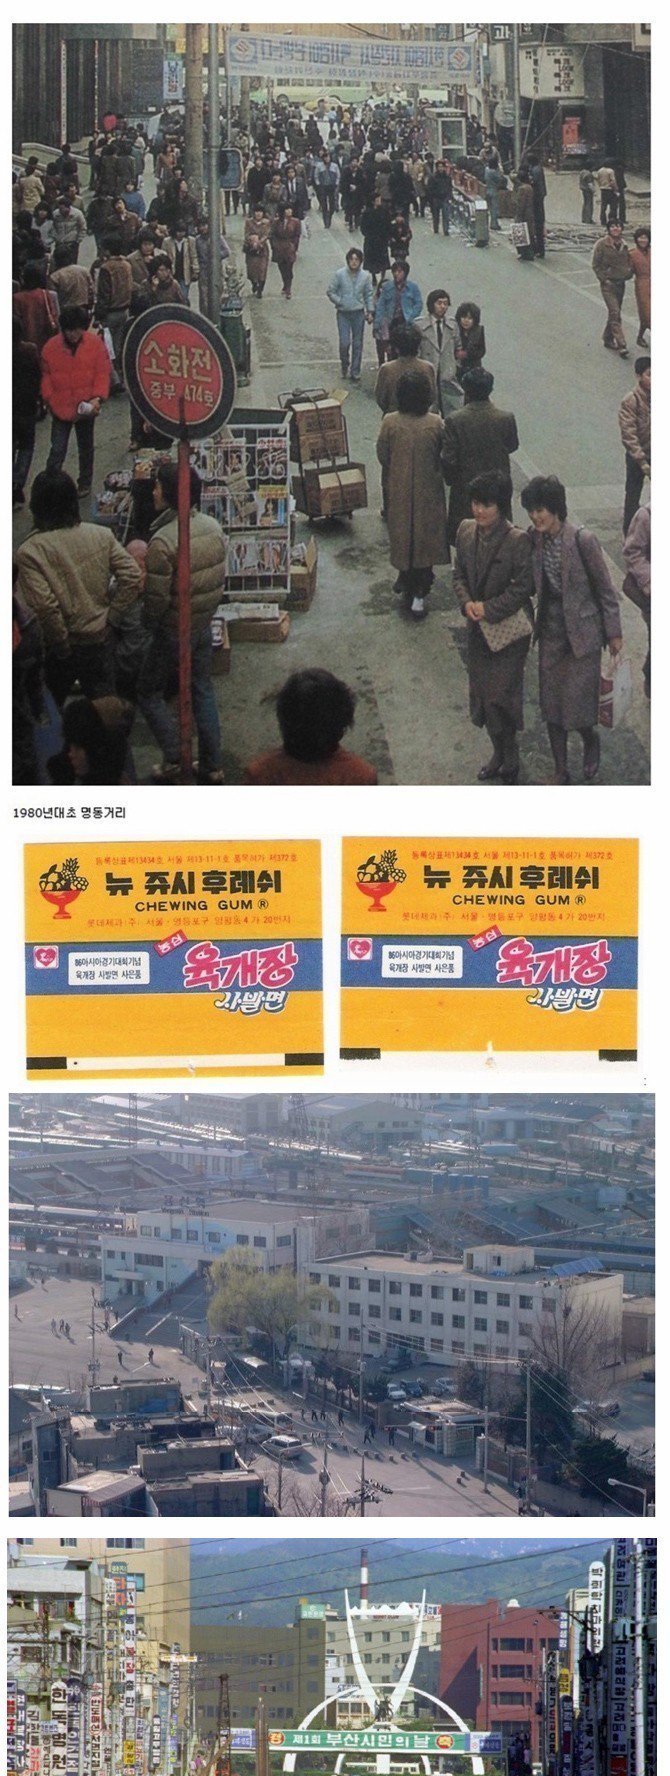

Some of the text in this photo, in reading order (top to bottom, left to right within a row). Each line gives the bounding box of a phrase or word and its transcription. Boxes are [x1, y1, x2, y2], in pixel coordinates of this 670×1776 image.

[144, 340, 212, 383] 소화전
[150, 381, 176, 400] 중부
[168, 856, 182, 864] 서울
[234, 854, 265, 863] 품목허가
[483, 852, 498, 860] 서울
[550, 852, 581, 860] 품목허가
[105, 870, 282, 896] 뉴 쥬시 후레쉬
[424, 865, 599, 889] 뉴 쥬시 후레쉬
[135, 900, 208, 912] CHEWING
[218, 899, 252, 910] GUM
[452, 894, 525, 905] CHEWING
[535, 894, 570, 905] GUM
[146, 918, 163, 927] 서울
[173, 917, 208, 926] 영등포구
[263, 915, 291, 925] 20번지
[462, 912, 477, 921] 서울
[488, 911, 524, 921] 영등포구
[578, 912, 605, 921] 20번지
[157, 934, 184, 952] 농심
[472, 928, 498, 947] 농심
[388, 950, 455, 961] 86아시아경기대회기념
[496, 936, 612, 986] 육개장
[75, 958, 141, 967] 86아시아경기대회기념
[183, 941, 298, 990] 육개장
[389, 963, 454, 974] 육개장 사발면 사은품
[76, 970, 141, 980] 육개장 사발면 사은품
[214, 991, 289, 1015] 사발면
[526, 987, 603, 1013] 사발면
[292, 1734, 321, 1745] 제1회
